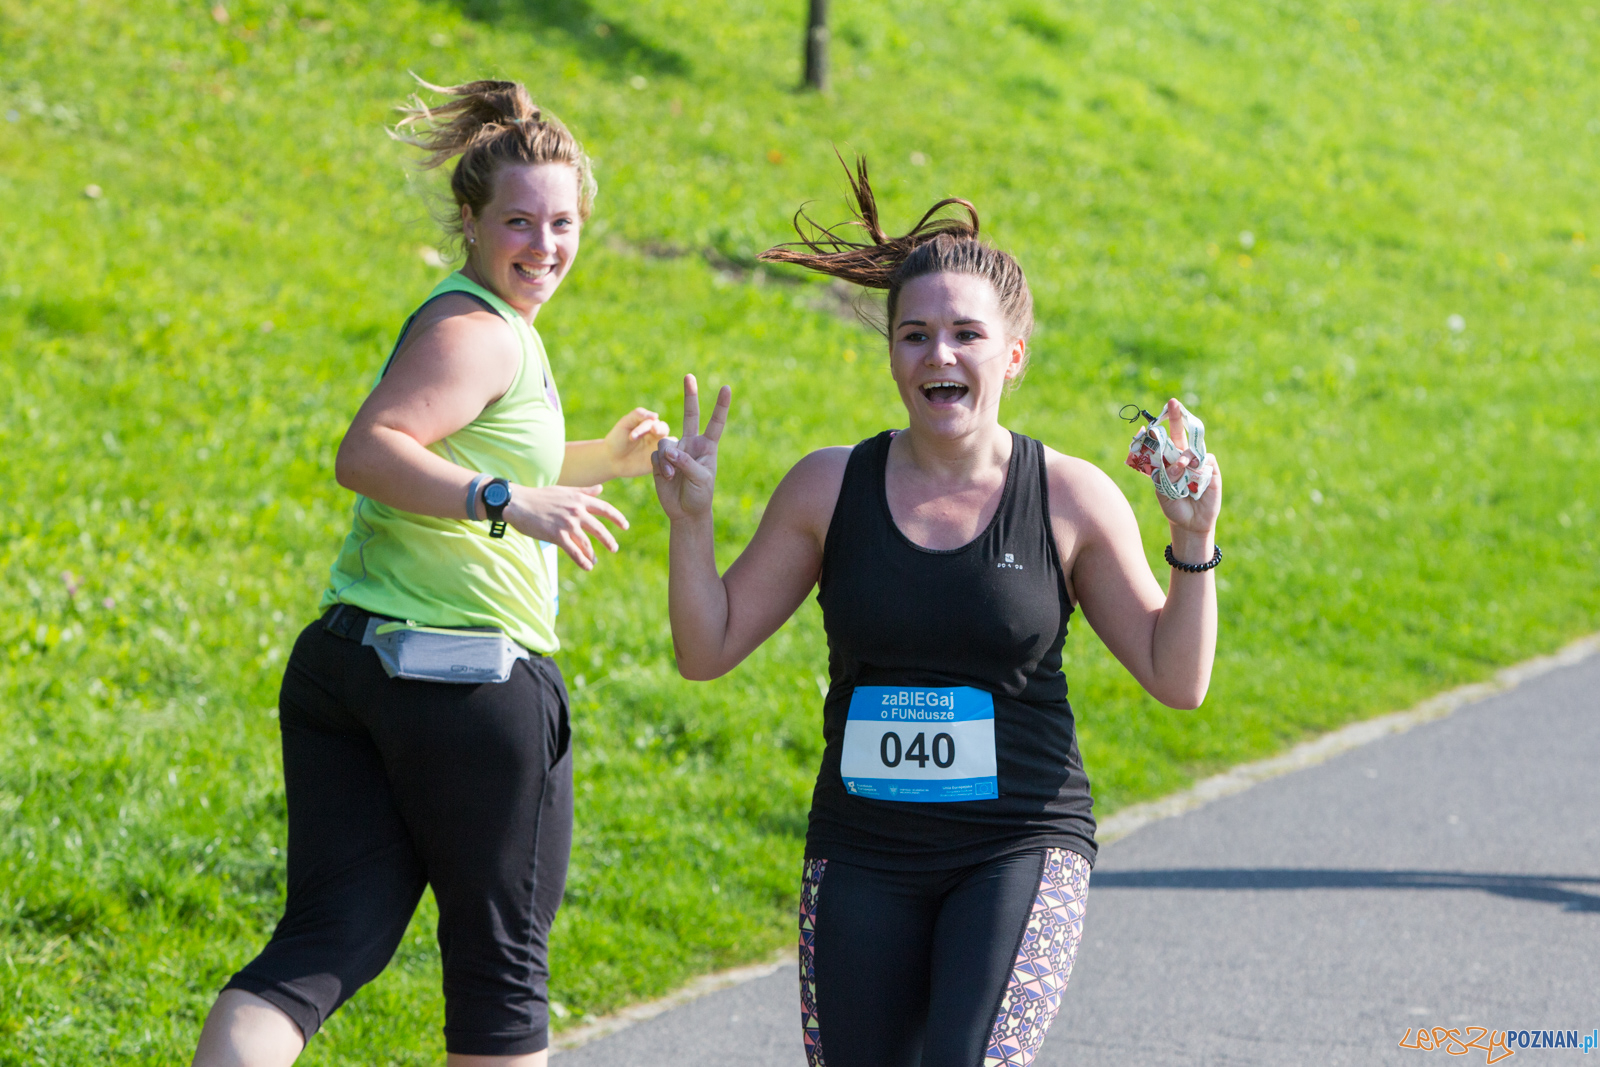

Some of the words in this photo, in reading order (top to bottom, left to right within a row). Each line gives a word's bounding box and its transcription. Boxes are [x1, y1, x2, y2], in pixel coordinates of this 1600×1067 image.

[881, 691, 955, 710] zaBIEGaj
[880, 710, 888, 719] o
[891, 708, 955, 720] FUNdusze
[880, 731, 955, 769] 040
